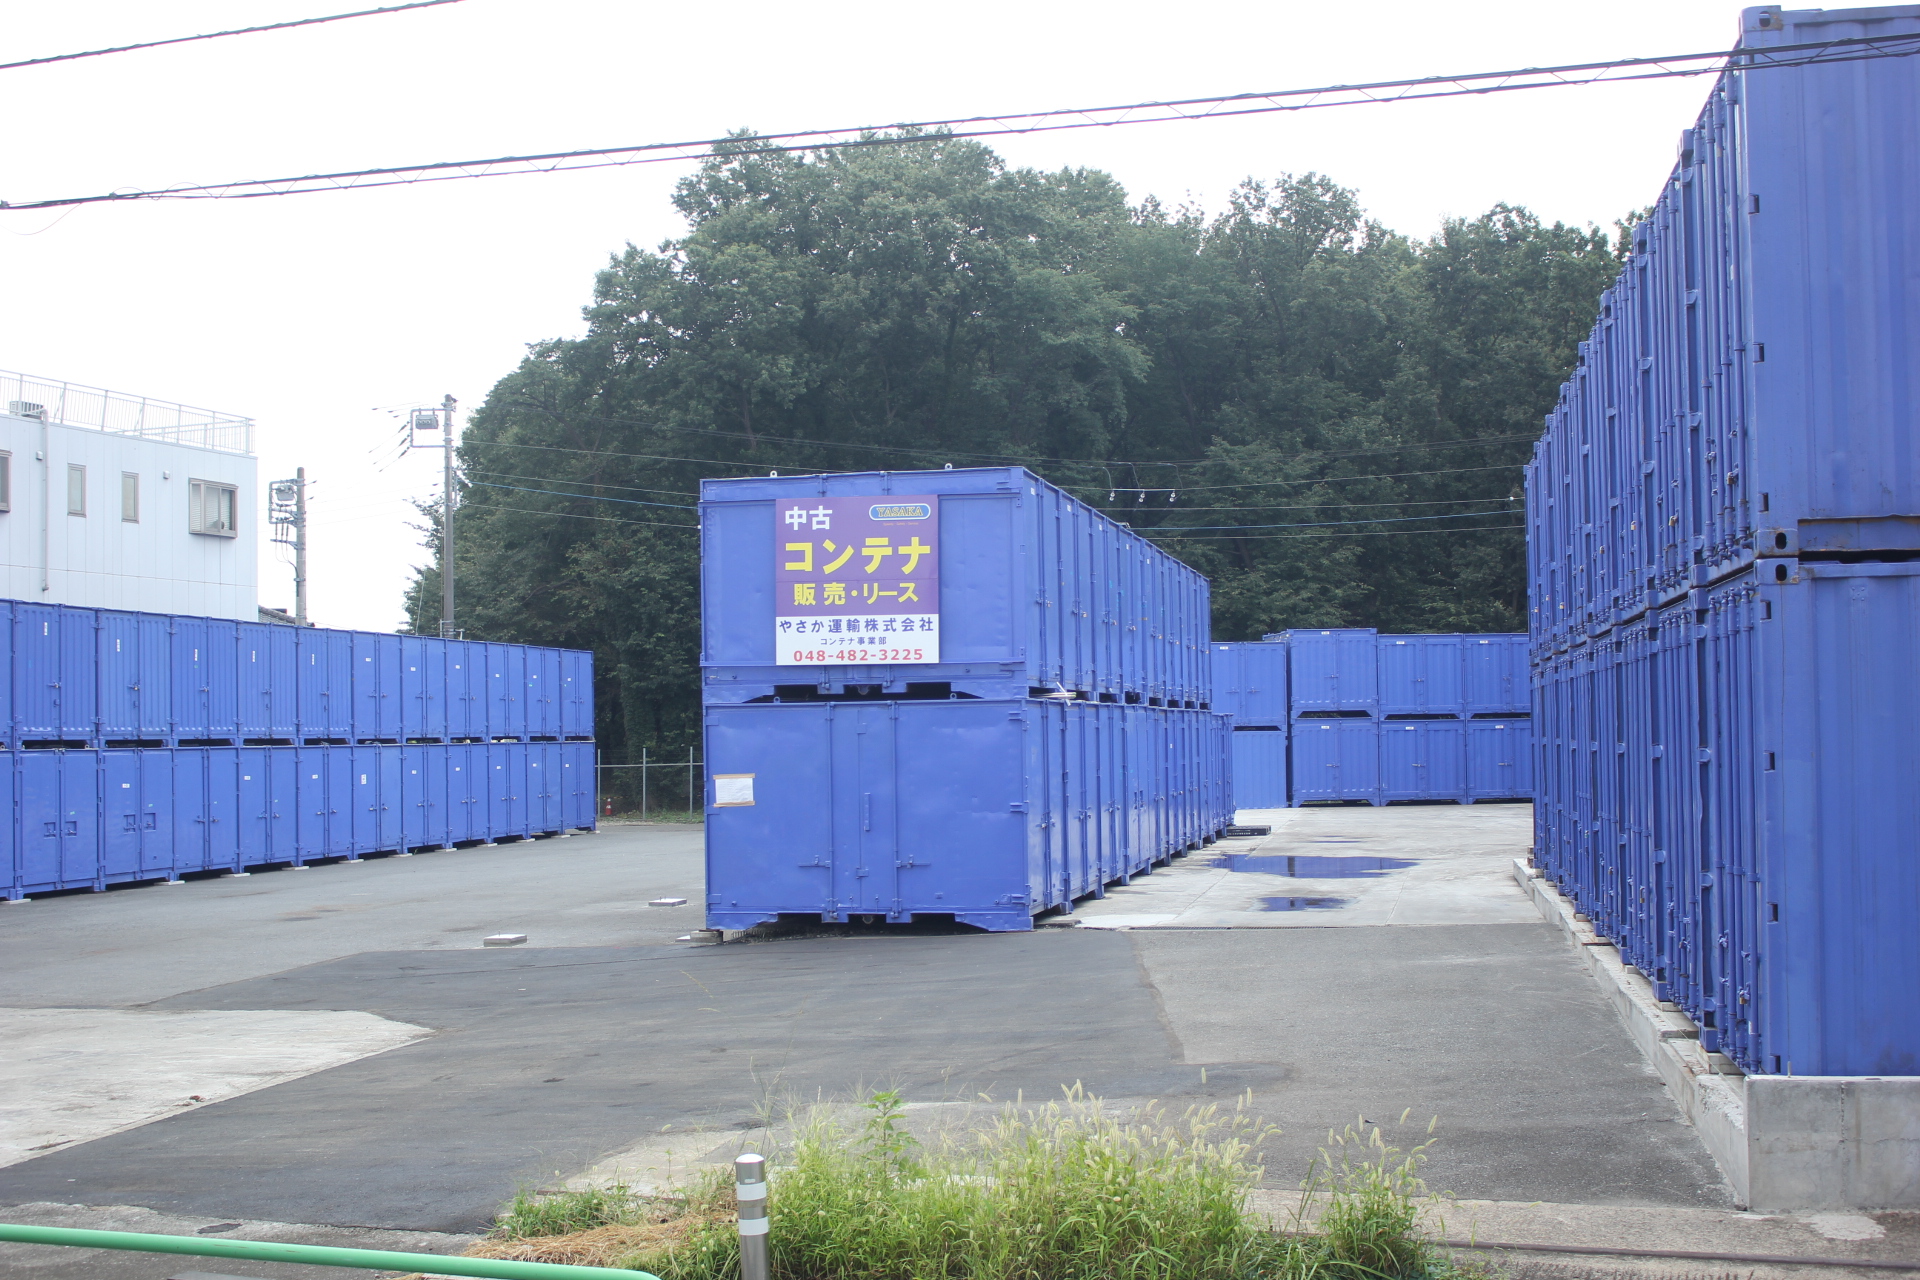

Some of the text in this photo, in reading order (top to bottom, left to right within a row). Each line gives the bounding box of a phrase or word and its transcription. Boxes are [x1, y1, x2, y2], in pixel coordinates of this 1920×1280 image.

[785, 505, 833, 530] 中古
[877, 506, 924, 517] YASAKA
[784, 536, 931, 575] コンテナ
[779, 617, 933, 633] やさか運輸株式会社
[820, 636, 887, 646] コンテナ事業部
[793, 648, 923, 662] 048-482-3225
